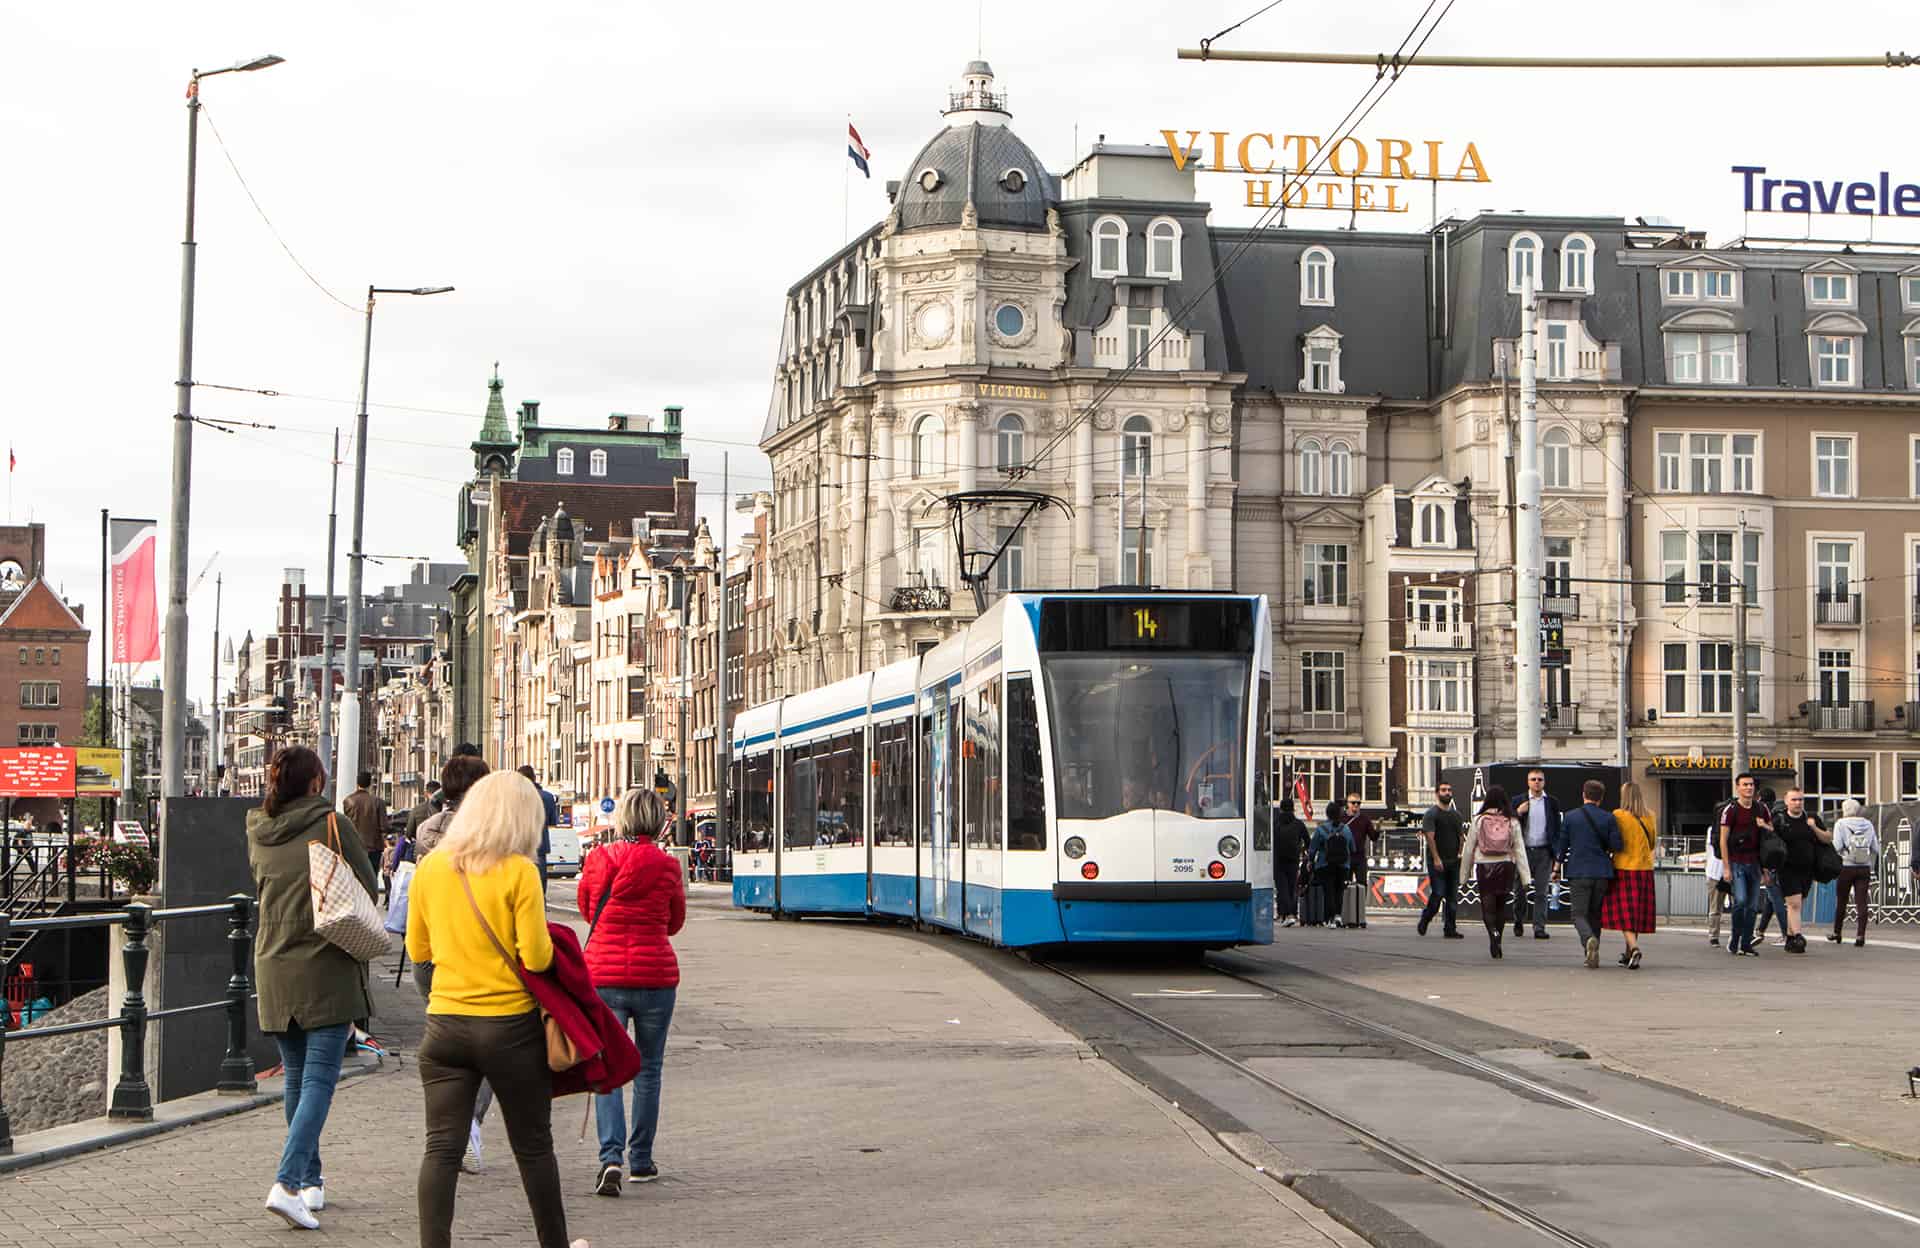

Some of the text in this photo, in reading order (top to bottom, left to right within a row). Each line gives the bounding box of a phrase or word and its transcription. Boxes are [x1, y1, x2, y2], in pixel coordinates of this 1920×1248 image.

[1159, 129, 1492, 182] VICTORIA
[1243, 180, 1409, 213] HOTEL
[1731, 165, 1920, 218] Travele
[903, 383, 1048, 401] HOTEL VICTORIA
[1133, 608, 1158, 640] 14
[1651, 755, 1795, 769] VICTORI HOTEL
[1173, 865, 1194, 873] 2095
